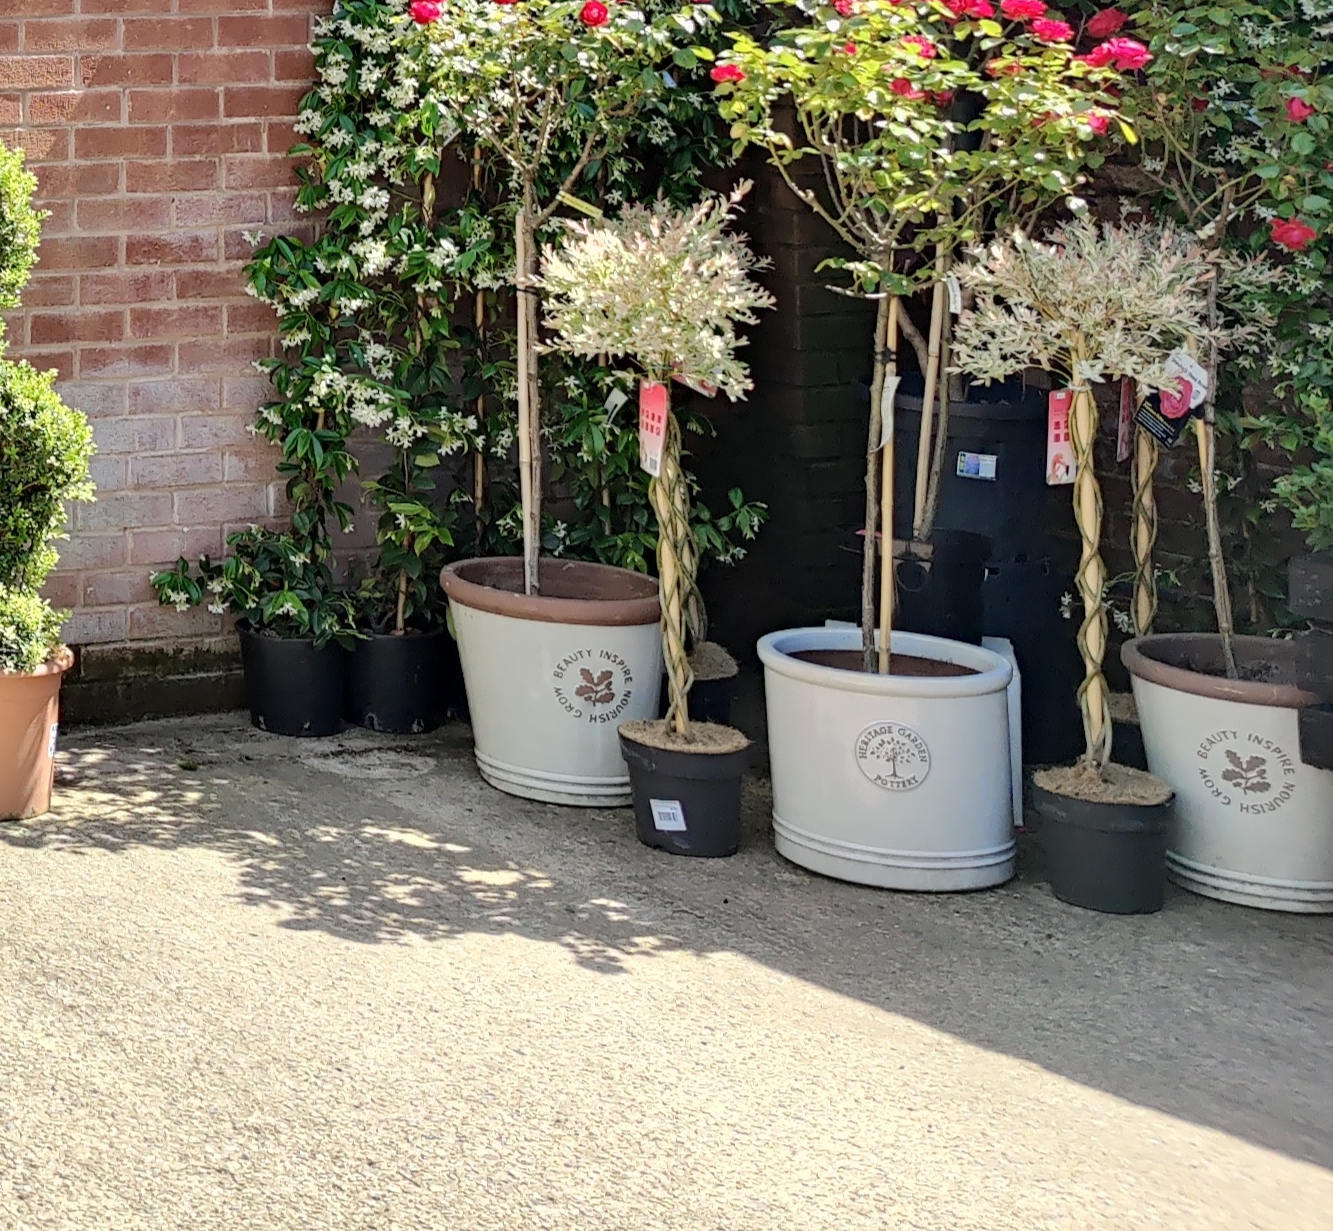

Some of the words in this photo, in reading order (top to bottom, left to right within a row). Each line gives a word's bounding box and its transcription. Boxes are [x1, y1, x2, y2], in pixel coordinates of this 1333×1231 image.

[553, 648, 592, 679] BEAUTY
[599, 649, 633, 685] INSPIRE
[553, 686, 583, 719] GROW
[589, 689, 632, 724] NOURISH
[858, 725, 893, 759] HERITAGE
[897, 727, 928, 763] GARDEN
[1196, 730, 1238, 760] BEAUTY
[1247, 733, 1295, 775] INSPIRE
[873, 774, 919, 789] POTTERY
[1198, 767, 1232, 806] GROW
[1240, 781, 1296, 815] NOURISH
